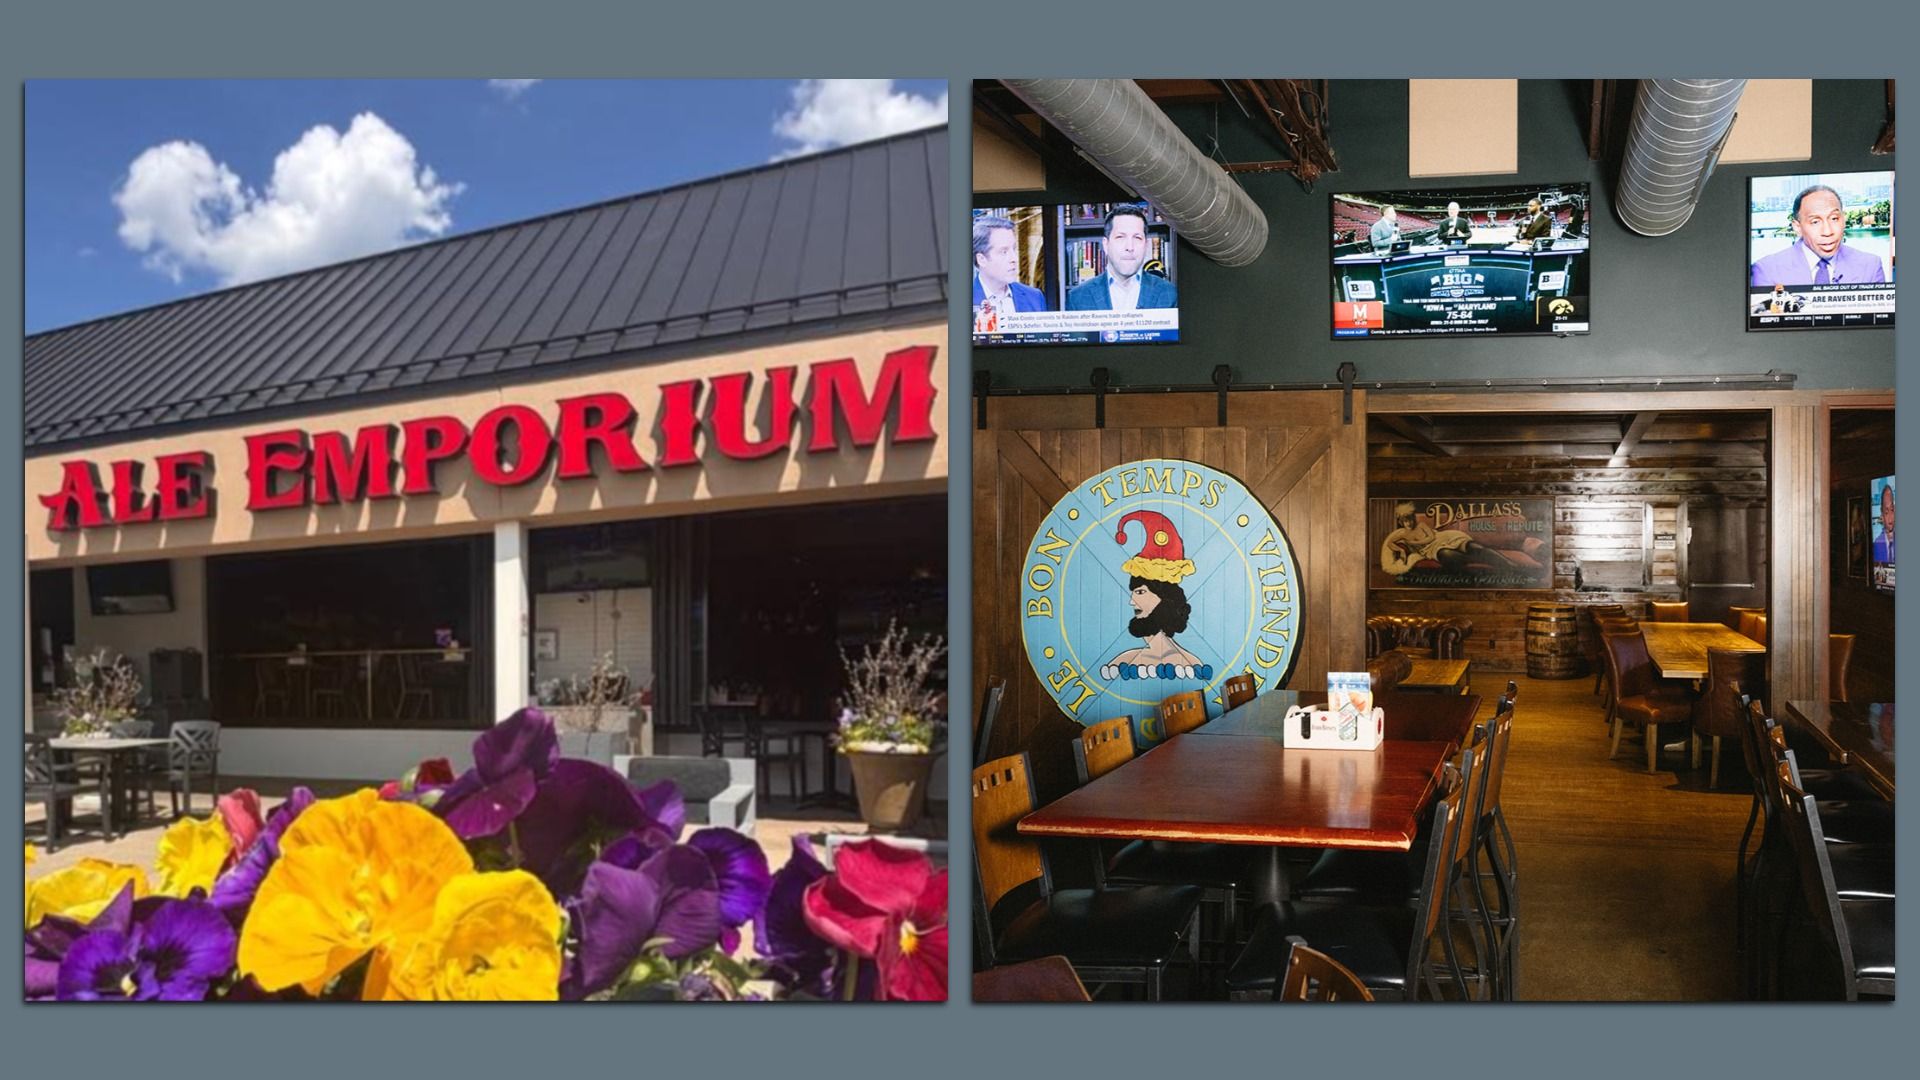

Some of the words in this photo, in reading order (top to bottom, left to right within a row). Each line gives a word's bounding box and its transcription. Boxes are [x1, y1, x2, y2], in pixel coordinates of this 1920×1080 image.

[1353, 303, 1368, 319] M
[1446, 311, 1473, 319] 75-64
[1828, 294, 1856, 302] RAVENS
[38, 450, 214, 532] ALE
[244, 345, 940, 511] EMPORIUM
[1089, 466, 1227, 510] TEMPS
[1425, 501, 1522, 530] DALLAS'S
[1469, 520, 1497, 532] HOUSE
[1026, 526, 1071, 619] BON
[1215, 527, 1292, 704] VIEND
[1047, 659, 1097, 716] LE
